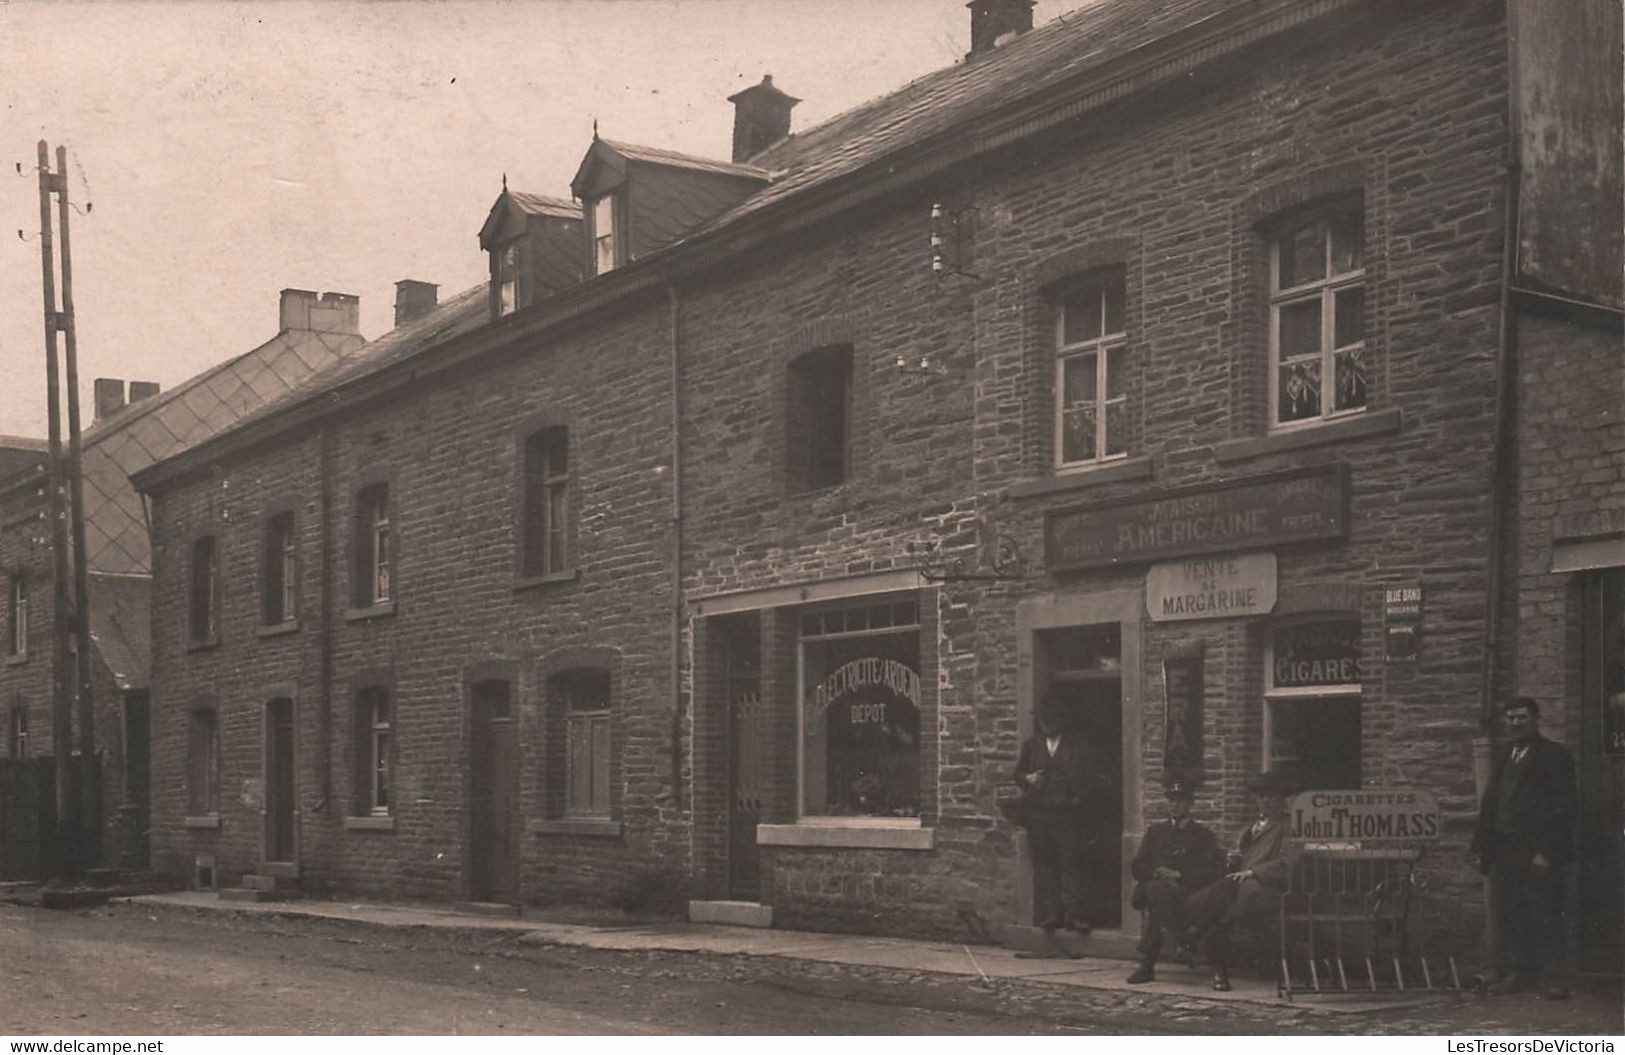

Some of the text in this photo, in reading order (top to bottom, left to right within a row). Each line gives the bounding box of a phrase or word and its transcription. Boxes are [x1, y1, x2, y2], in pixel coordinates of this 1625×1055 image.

[1113, 508, 1268, 551] AMERICAINE
[1184, 559, 1239, 581] VENTE
[1162, 587, 1257, 616] MARGARINE
[1386, 588, 1401, 603] BLUE
[1311, 792, 1416, 808] CIGARETTES
